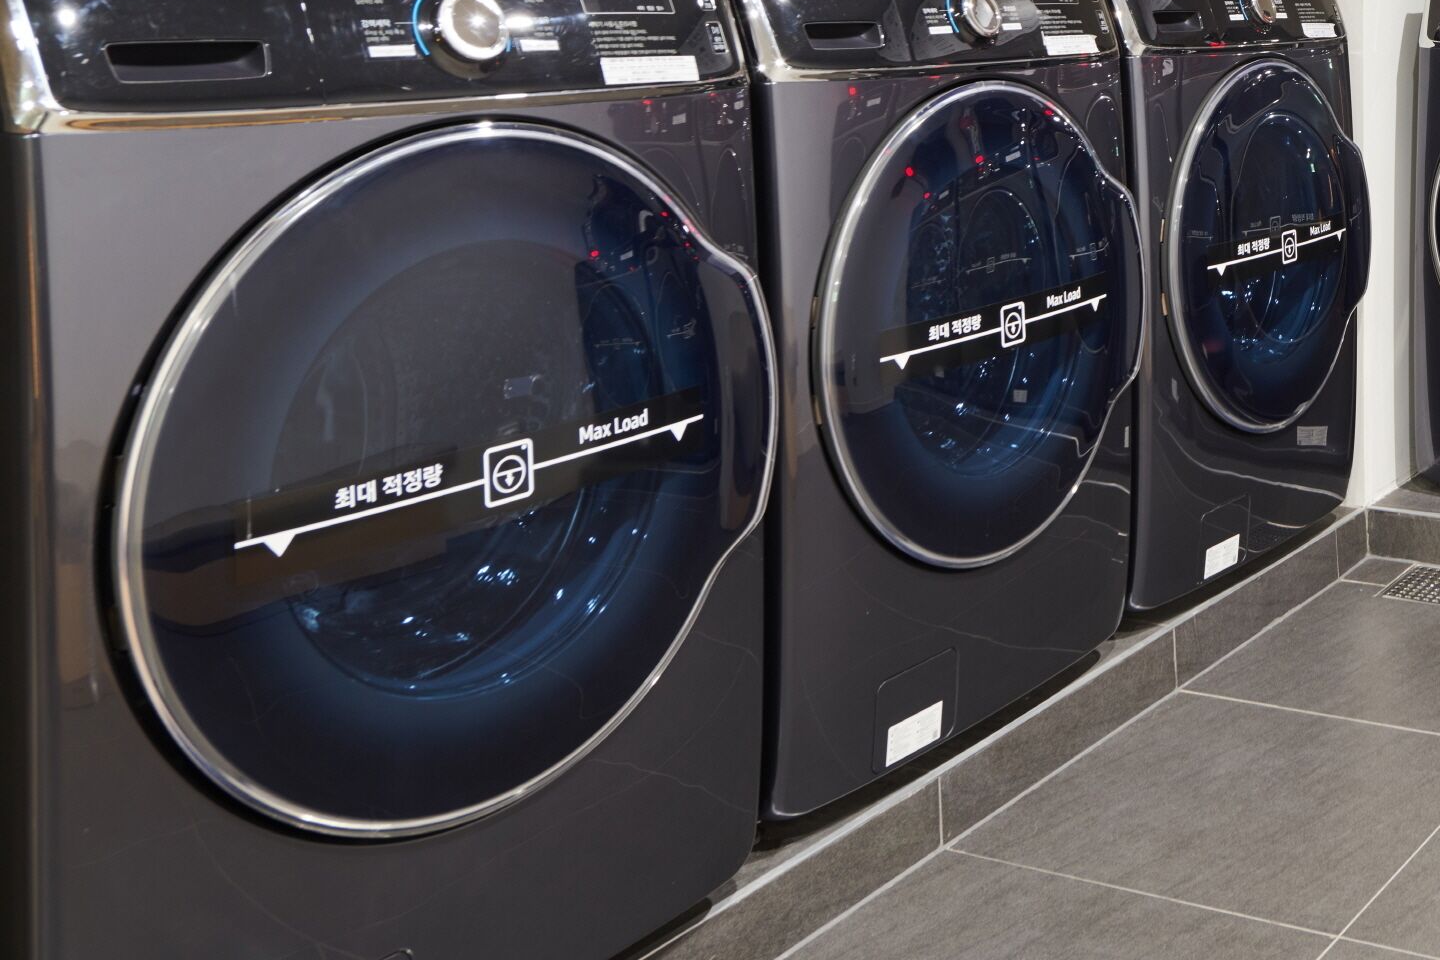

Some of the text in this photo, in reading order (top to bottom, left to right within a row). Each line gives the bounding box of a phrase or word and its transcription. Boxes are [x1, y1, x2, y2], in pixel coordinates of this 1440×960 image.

[1310, 220, 1331, 236] Max Load
[1237, 237, 1270, 256] 최대 적정량
[1046, 286, 1081, 309] Max Load
[928, 314, 982, 341] 최대 적정량
[578, 407, 650, 445] Max Load
[334, 463, 444, 511] 최대 적정량
